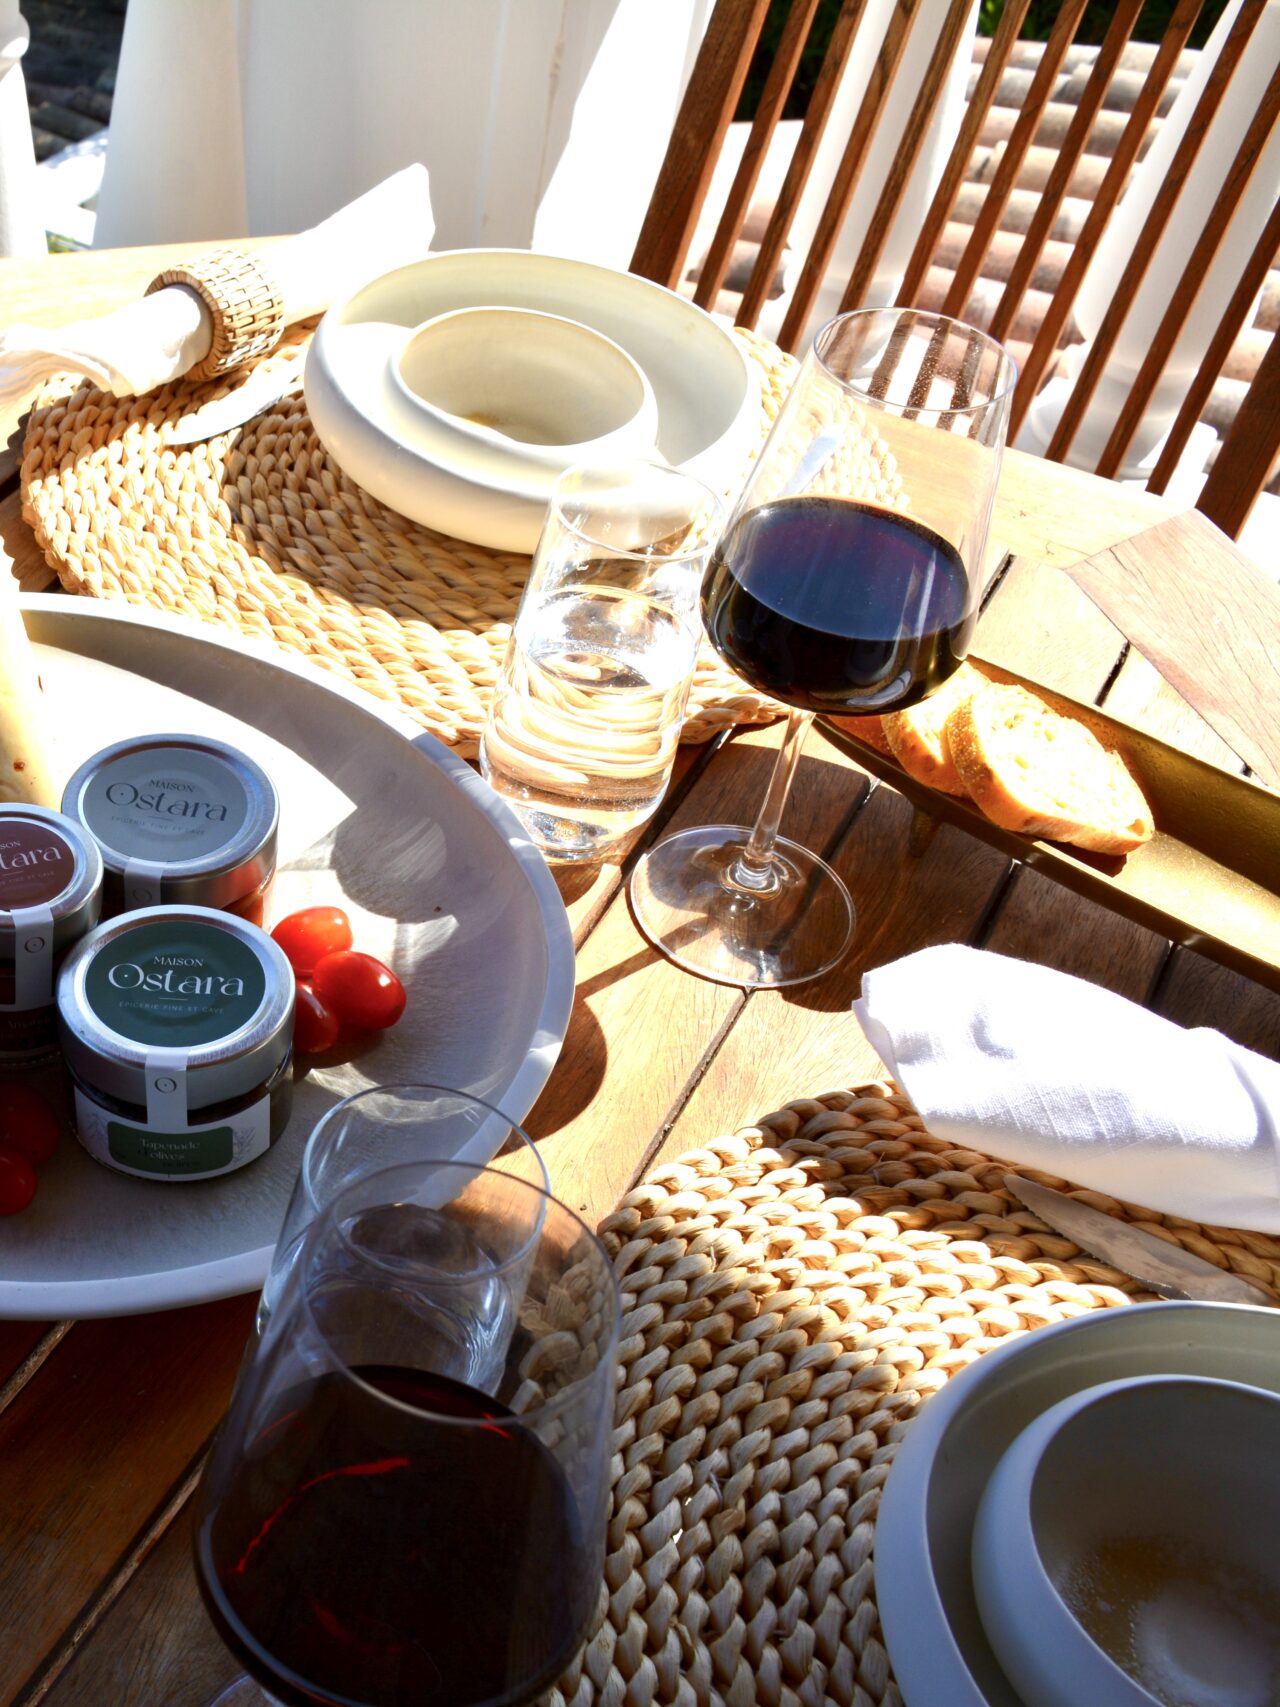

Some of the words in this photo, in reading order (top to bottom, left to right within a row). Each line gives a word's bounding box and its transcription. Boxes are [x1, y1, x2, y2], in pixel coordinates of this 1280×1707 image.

[150, 779, 195, 793] MAISON
[106, 782, 227, 821] Ostara
[153, 955, 204, 967] MAISON
[108, 963, 244, 996] Ostara
